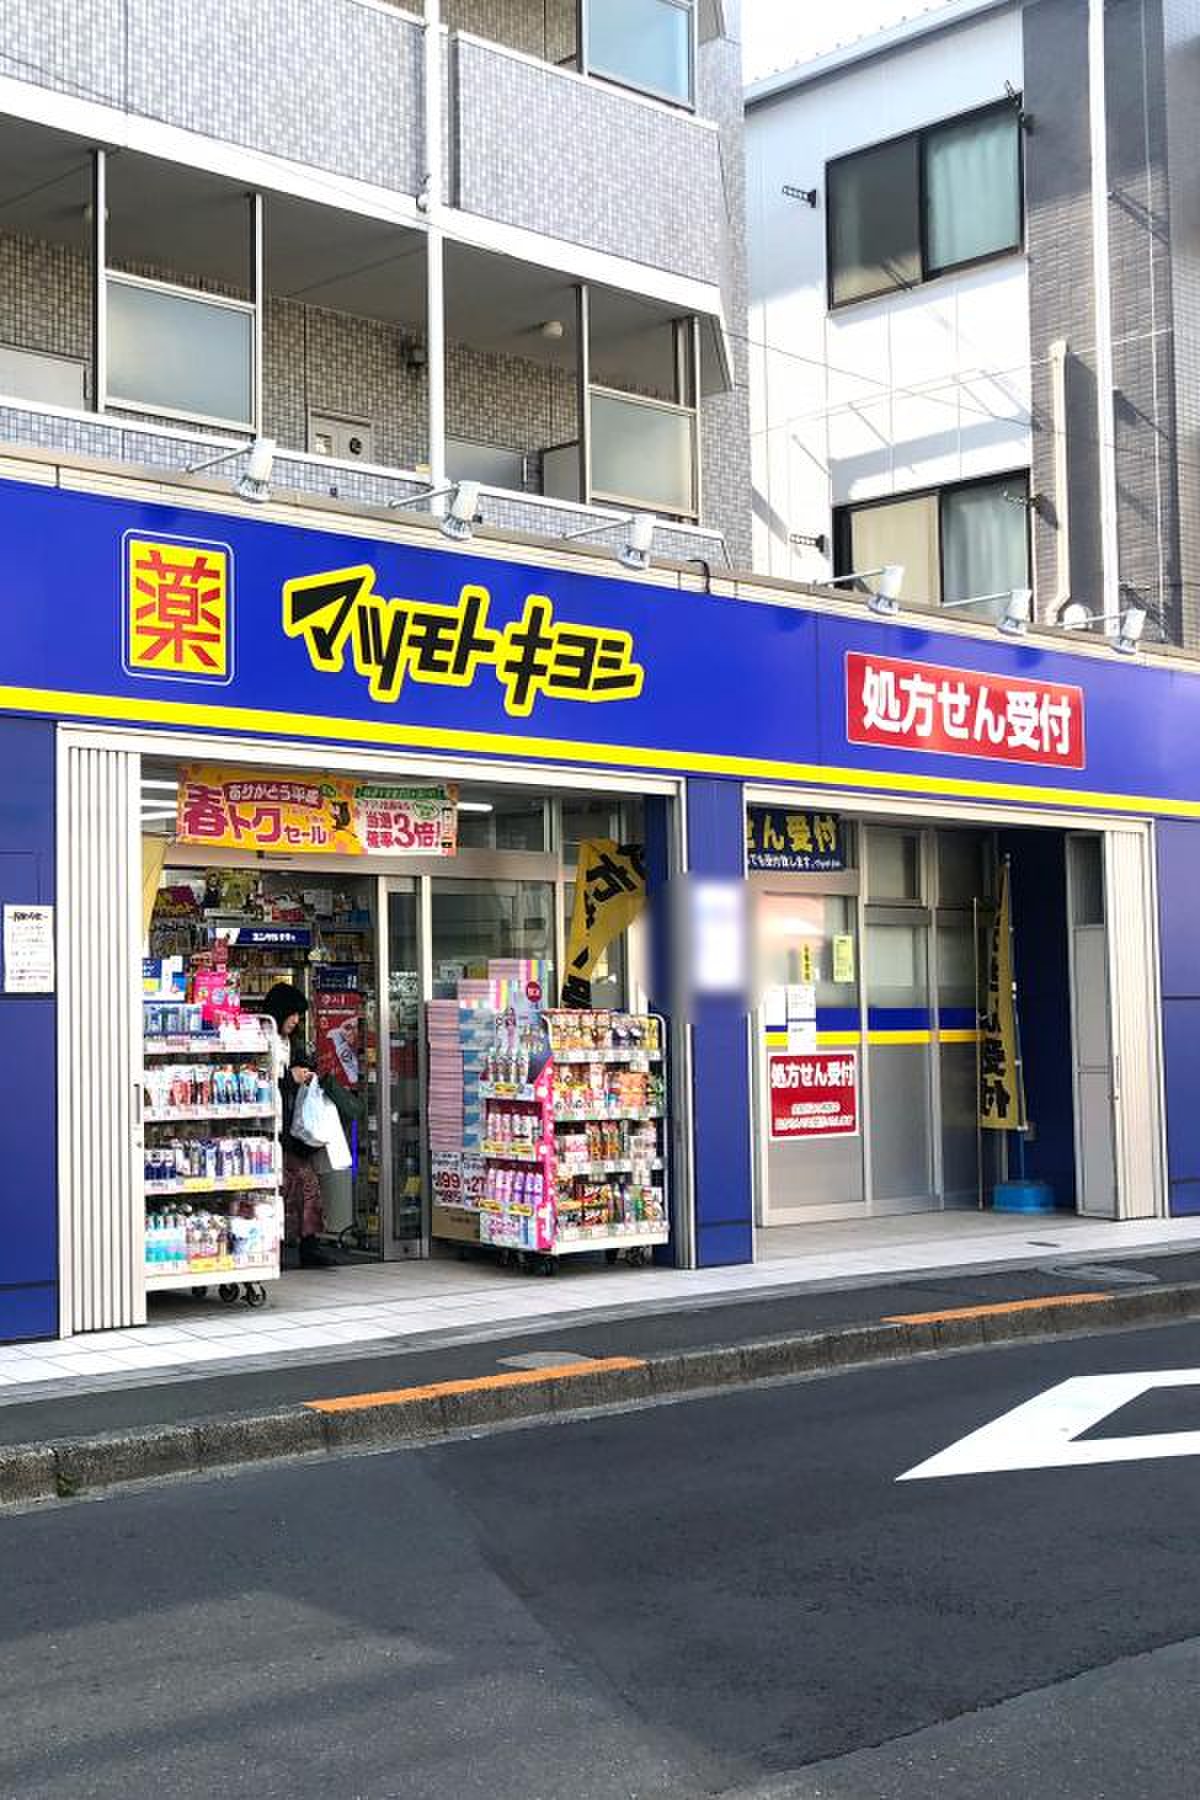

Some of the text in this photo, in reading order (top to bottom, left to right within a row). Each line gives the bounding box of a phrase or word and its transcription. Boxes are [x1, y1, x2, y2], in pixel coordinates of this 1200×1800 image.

[135, 548, 221, 669] 薬
[288, 571, 641, 708] マツモトキヨシ
[861, 665, 1072, 756] 処方せん受付
[771, 1061, 855, 1089] 処方せん受付
